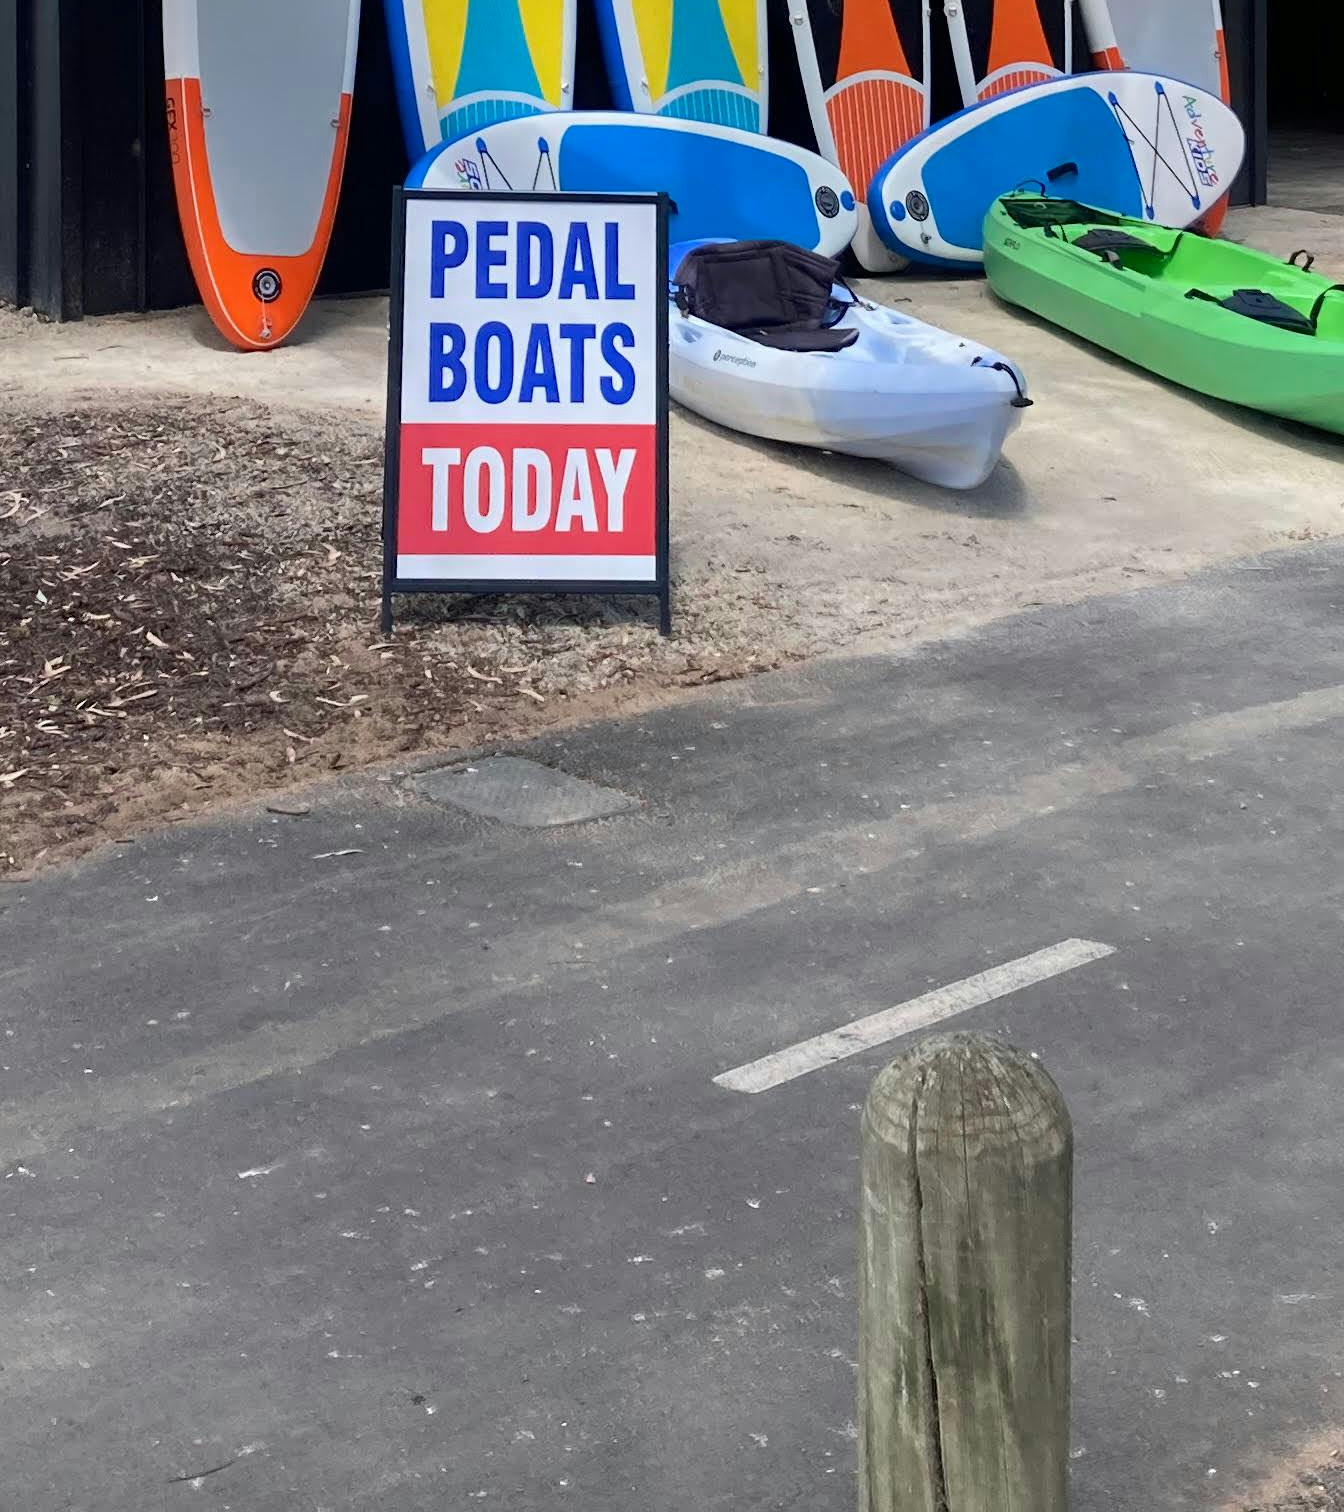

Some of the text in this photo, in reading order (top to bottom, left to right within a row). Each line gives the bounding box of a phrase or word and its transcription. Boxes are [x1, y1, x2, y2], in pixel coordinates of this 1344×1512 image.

[1182, 95, 1219, 186] Adventure
[1186, 137, 1214, 187] KIDS
[430, 220, 636, 301] PEDAL
[428, 320, 636, 406] BOATS
[421, 445, 637, 534] TODAY
